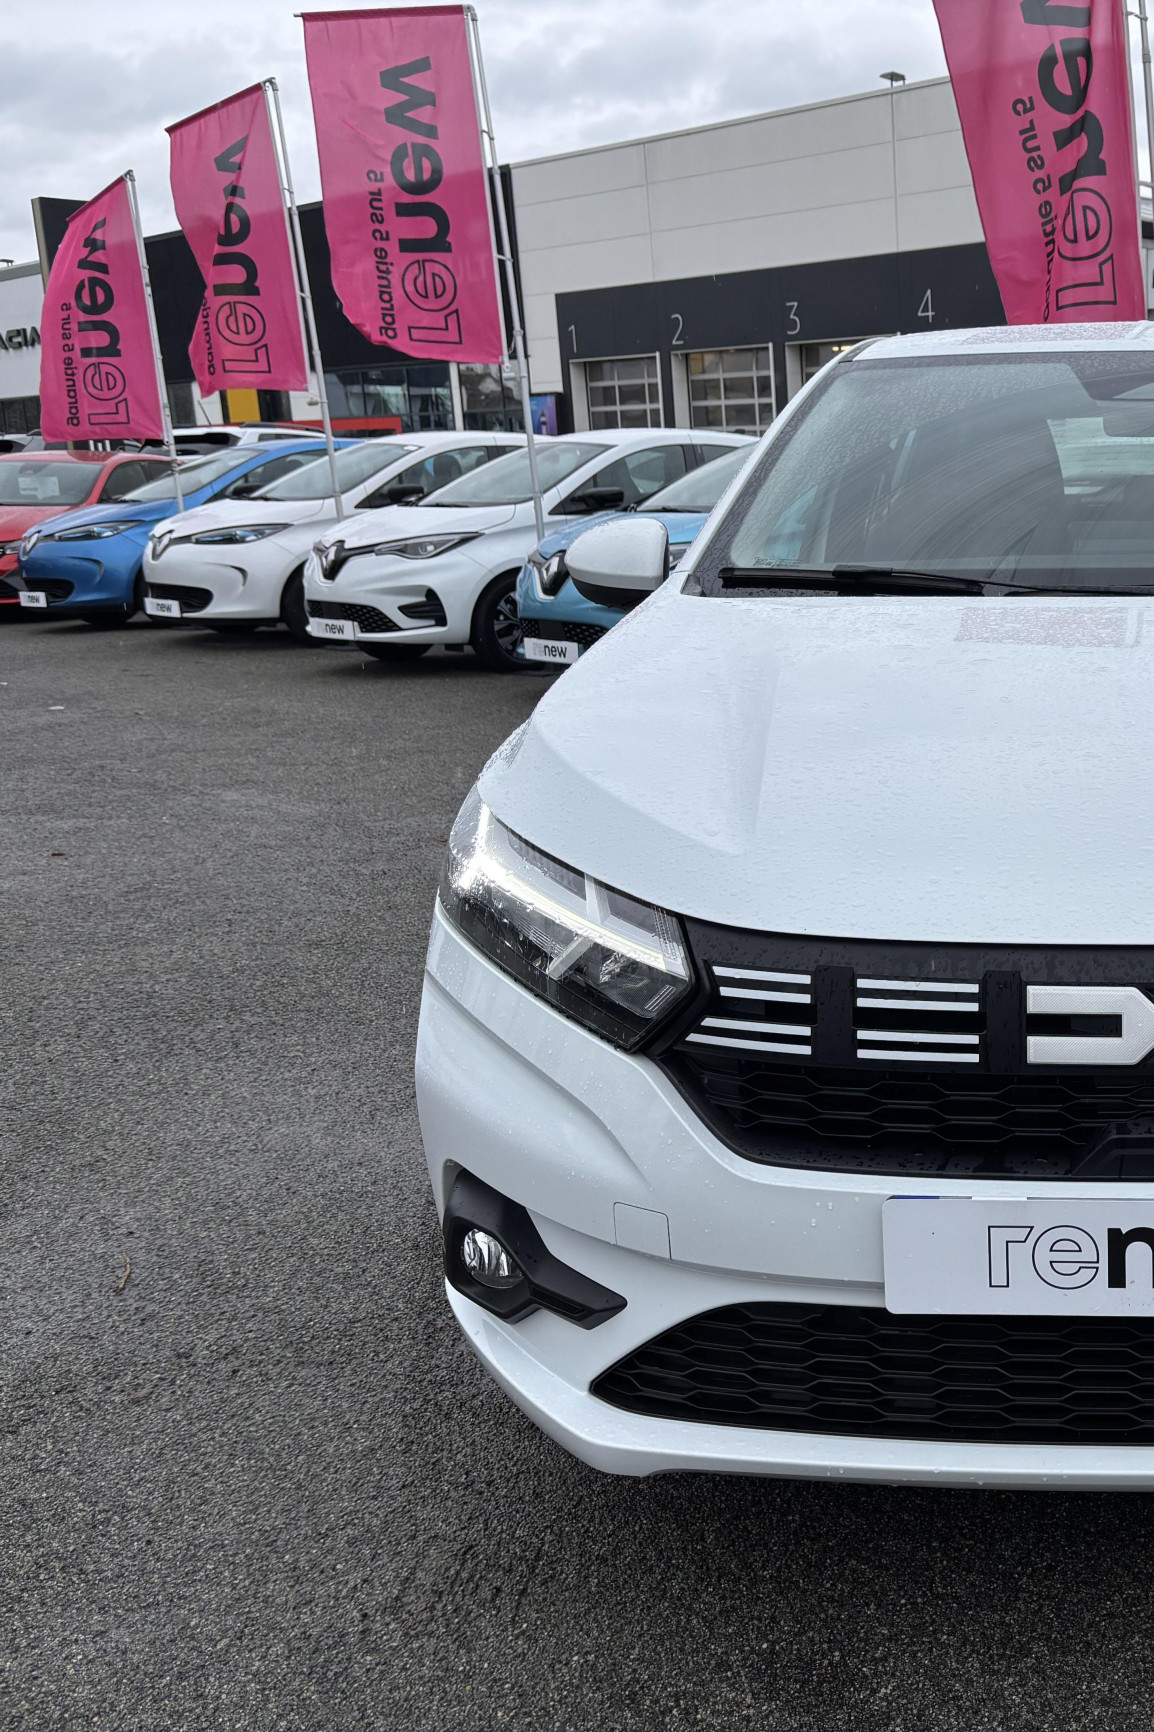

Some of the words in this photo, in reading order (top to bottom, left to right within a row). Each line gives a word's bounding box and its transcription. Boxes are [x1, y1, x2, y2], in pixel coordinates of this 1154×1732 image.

[785, 301, 800, 335] 3
[917, 289, 936, 323] 4
[568, 325, 578, 353] 1
[671, 314, 685, 345] 2
[316, 622, 345, 635] new
